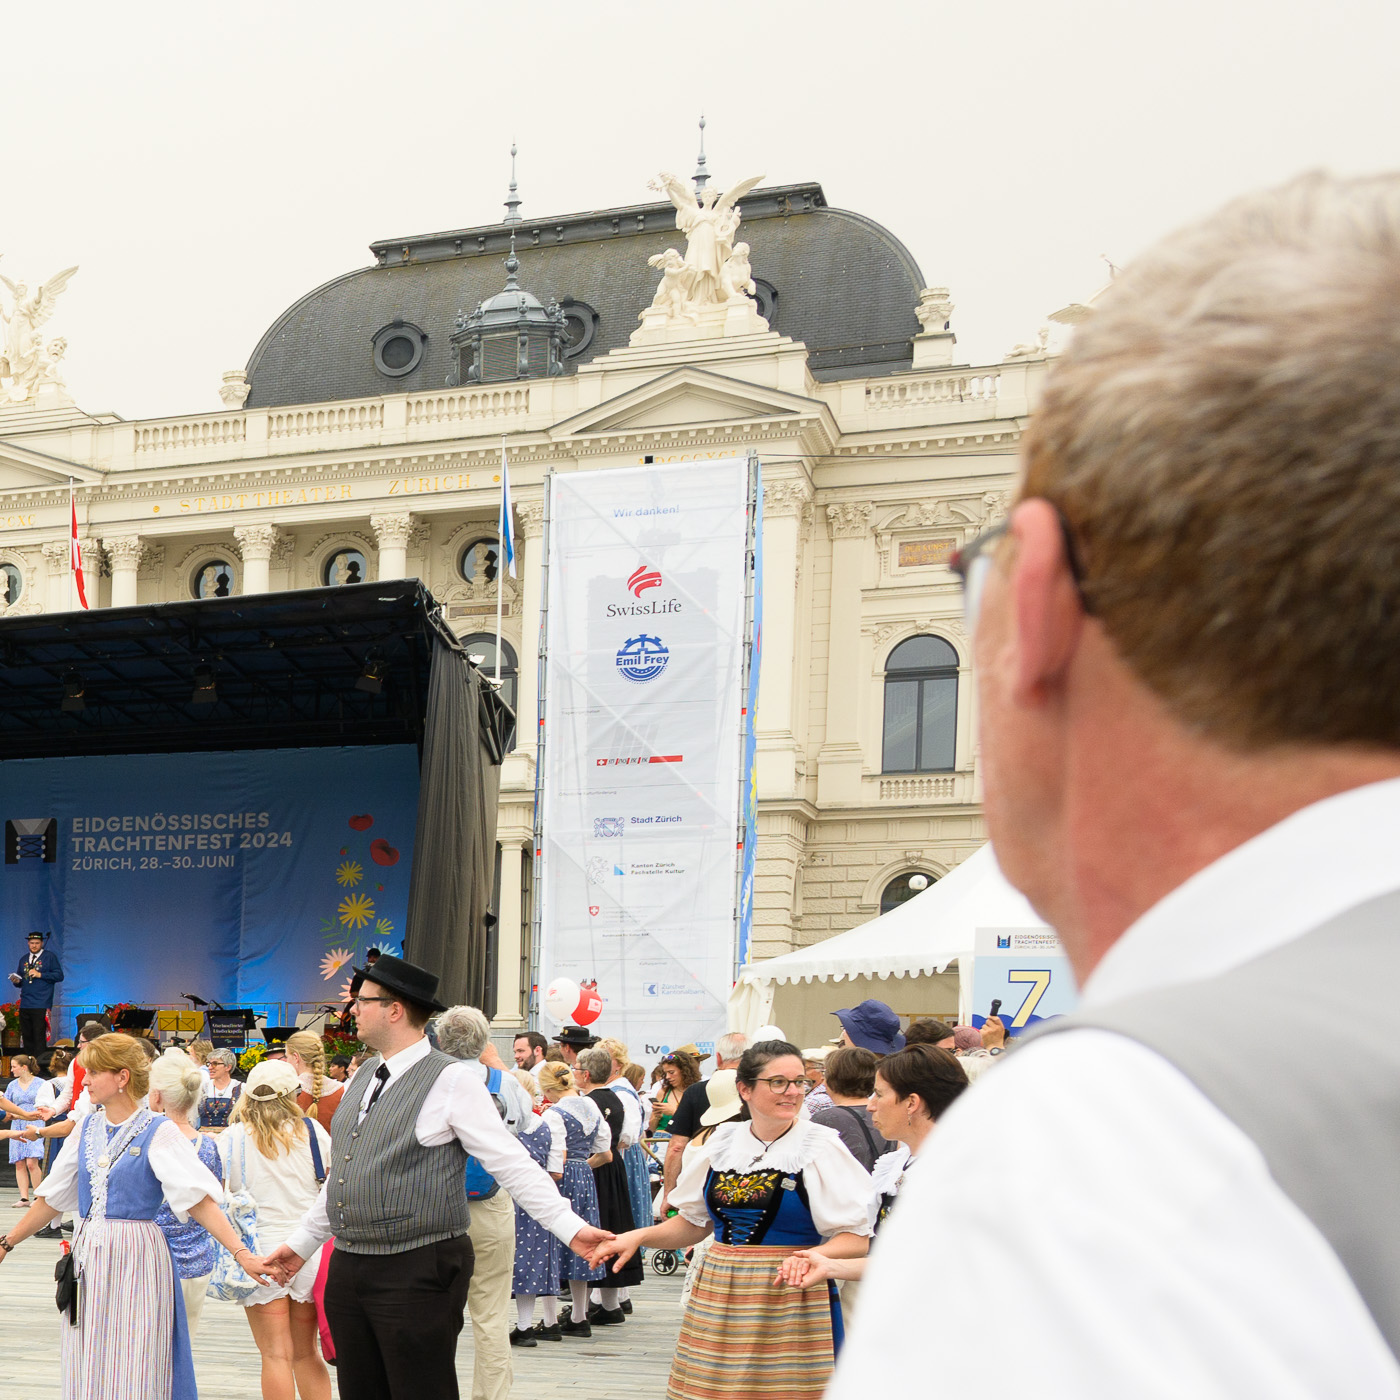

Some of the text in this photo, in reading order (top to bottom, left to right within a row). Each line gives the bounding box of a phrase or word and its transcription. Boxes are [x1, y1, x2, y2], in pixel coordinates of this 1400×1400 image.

[613, 504, 680, 518] Wir danken!
[606, 598, 682, 618] SwissLife
[615, 654, 670, 667] Emil Frey
[72, 812, 270, 833] EIDGENÖSSISCHES
[630, 815, 682, 824] Stadt Zürich
[71, 831, 293, 853] TRACHTENFEST 2024
[71, 856, 137, 872] ZÜRICH,
[1008, 969, 1052, 1028] 7
